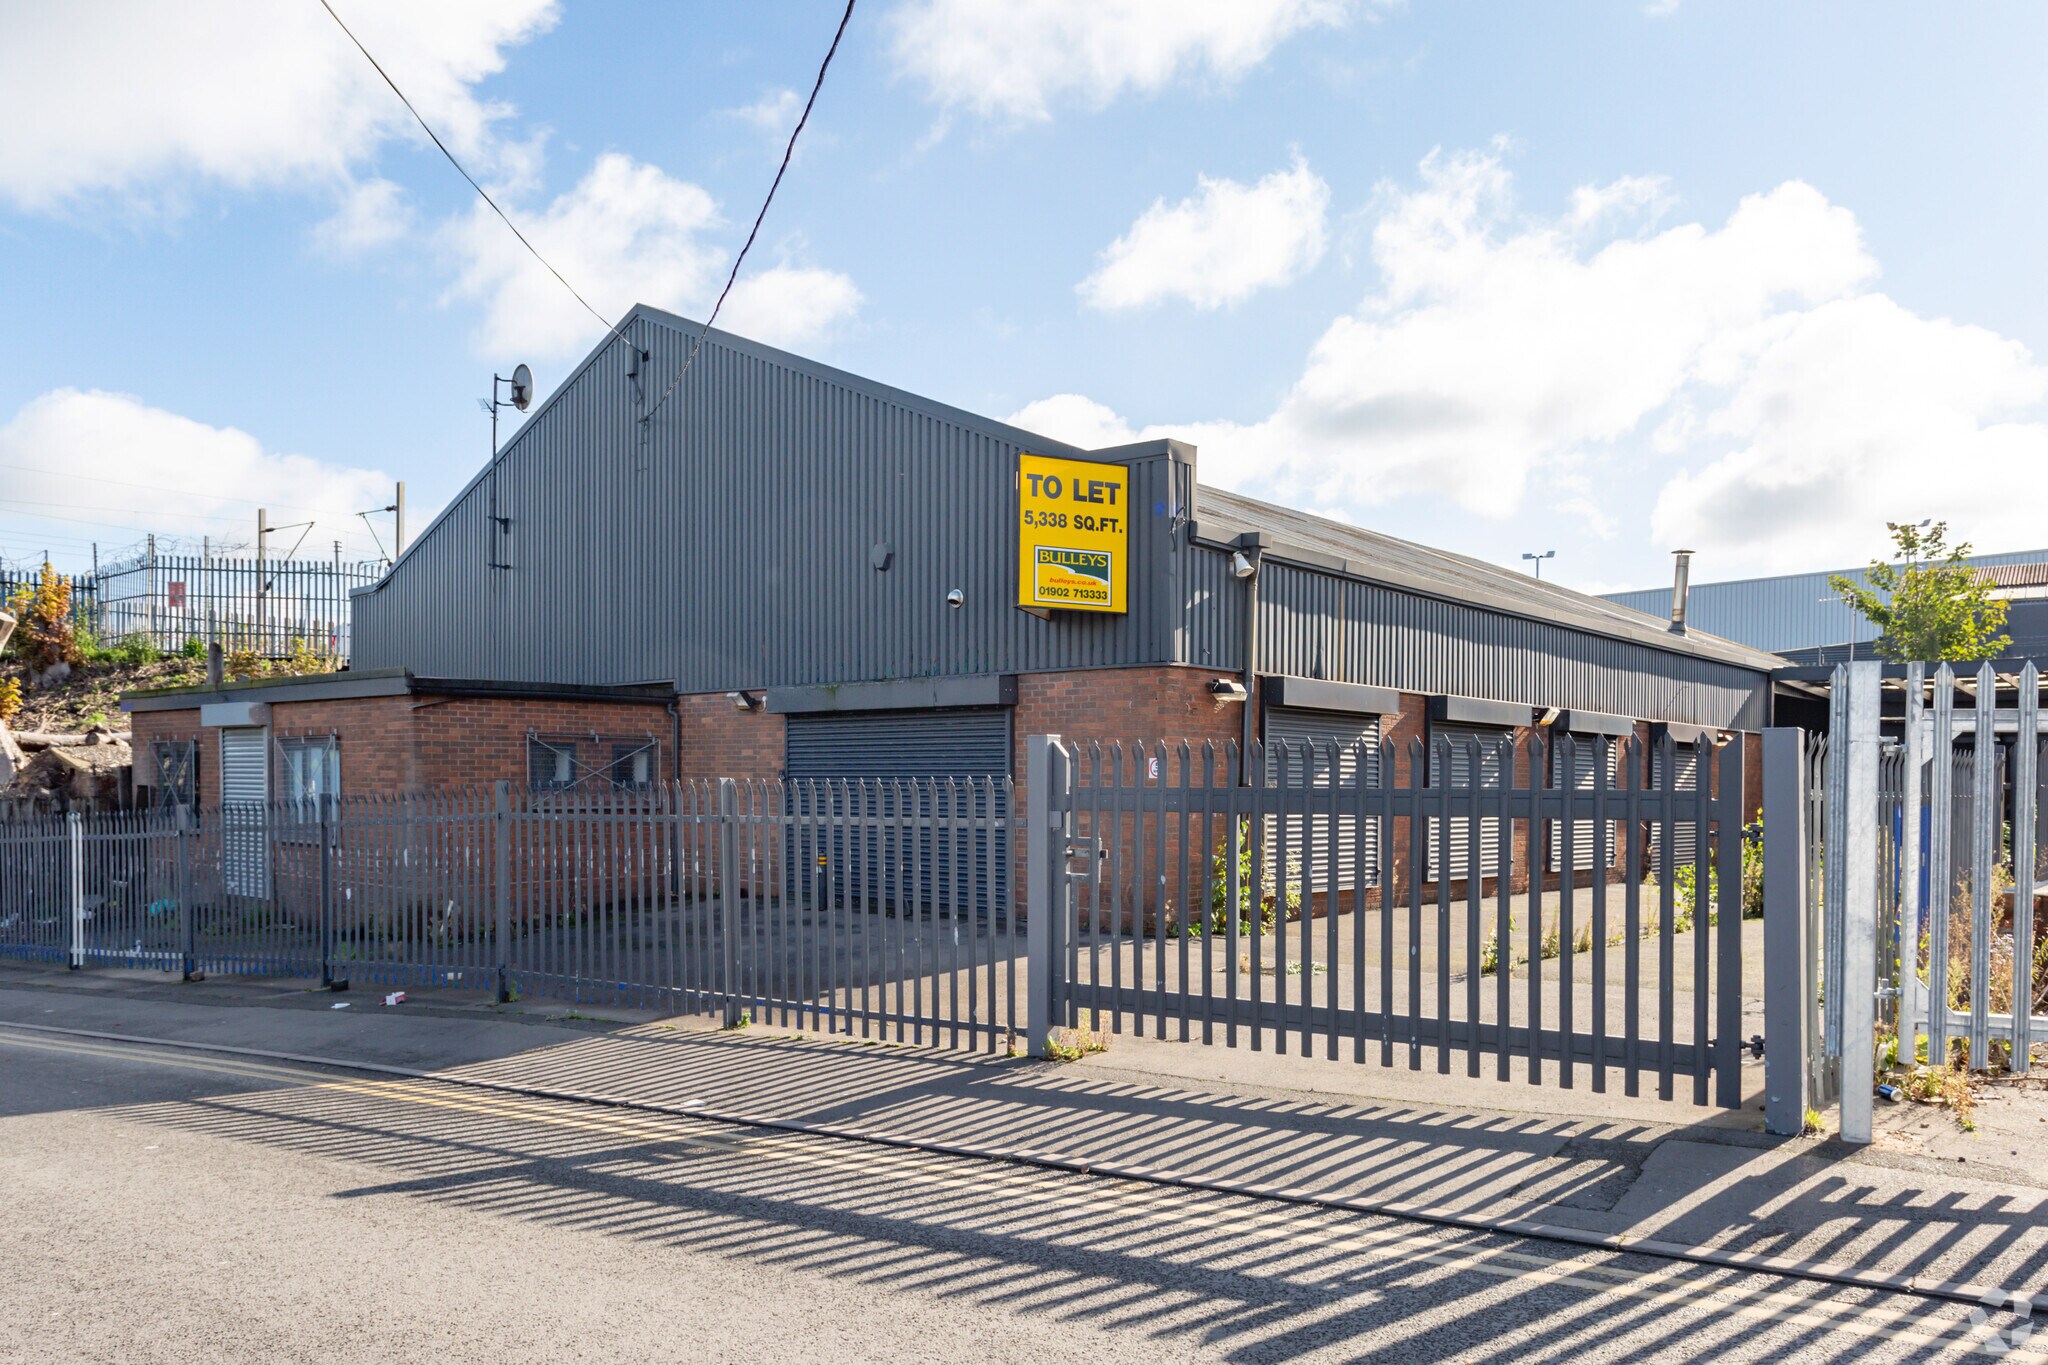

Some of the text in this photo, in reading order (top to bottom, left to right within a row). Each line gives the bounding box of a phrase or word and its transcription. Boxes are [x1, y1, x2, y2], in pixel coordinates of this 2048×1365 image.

[1026, 473, 1121, 505] TO LET
[1024, 510, 1123, 533] 5,338 SQ.FT.
[1039, 551, 1107, 567] BULLEYS
[1049, 577, 1097, 586] bulleys.co.uk
[1039, 586, 1107, 600] 01902 713333
